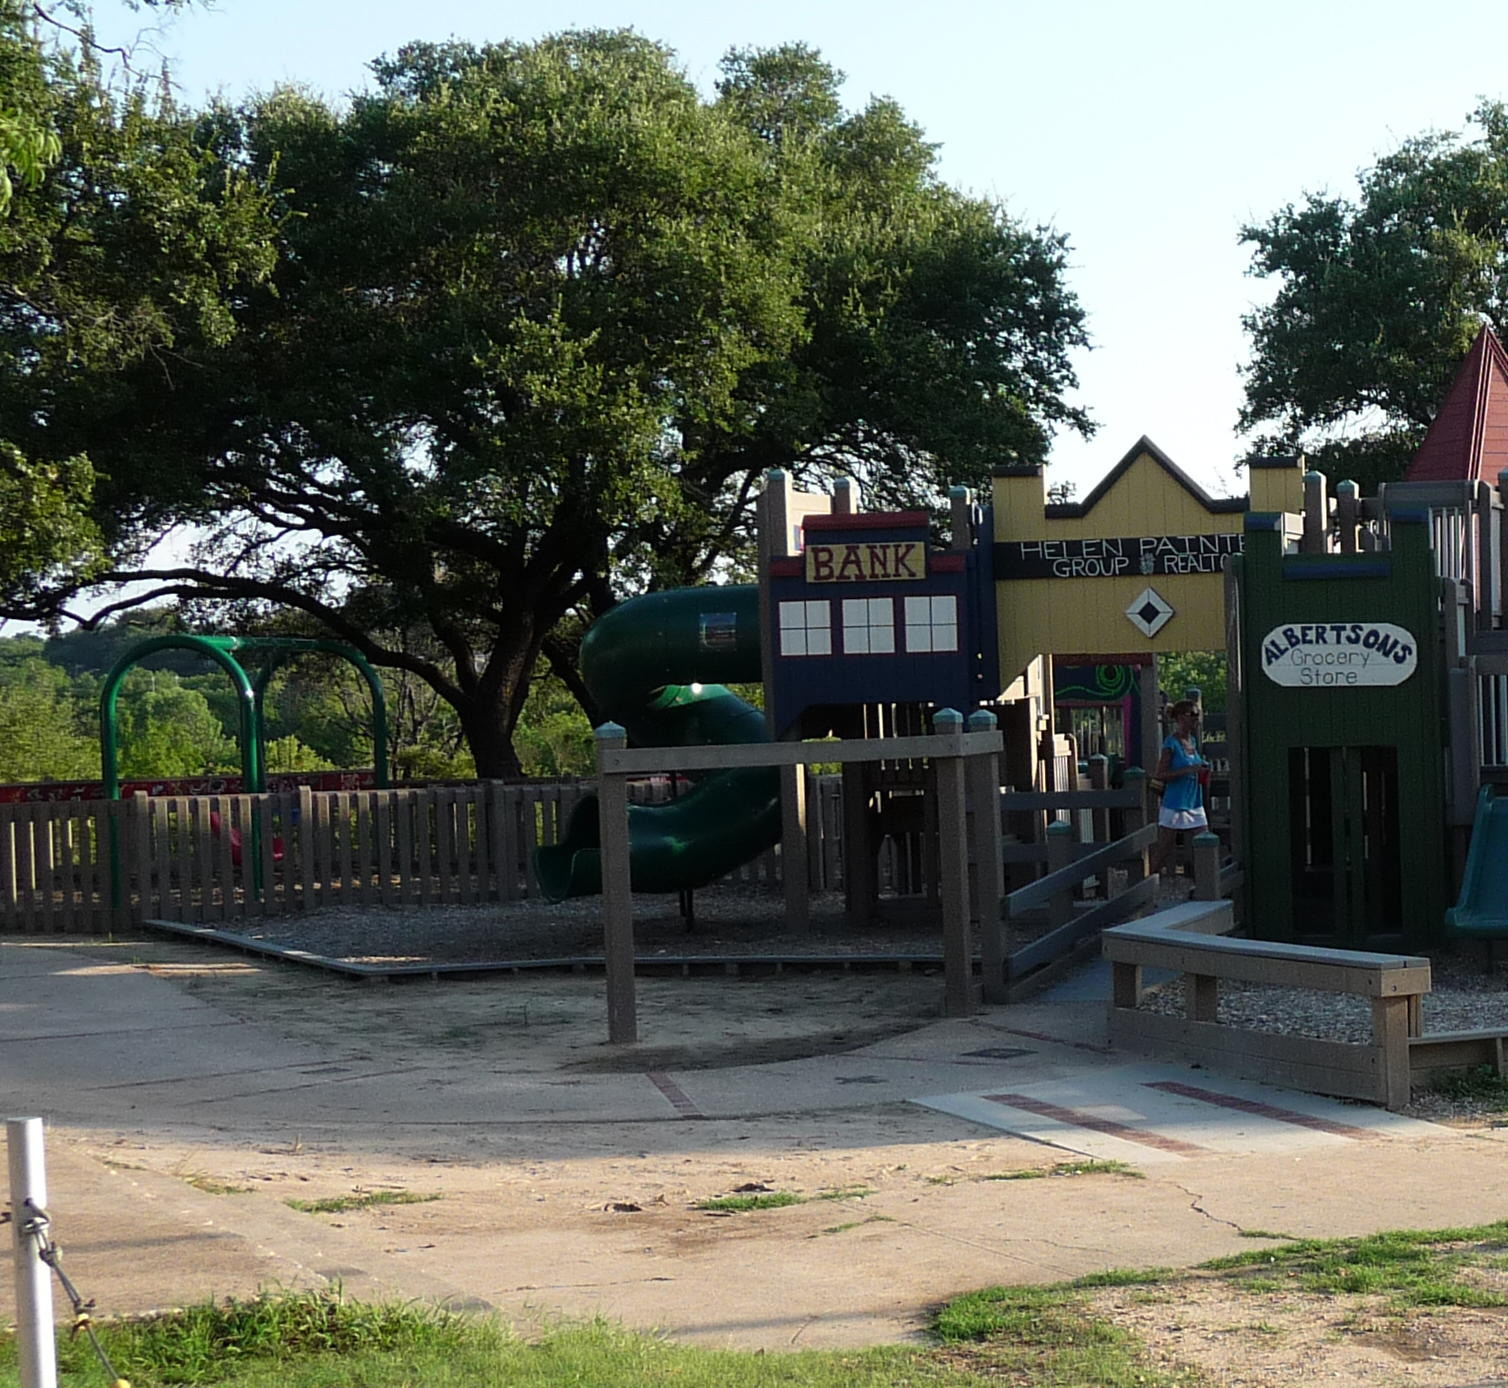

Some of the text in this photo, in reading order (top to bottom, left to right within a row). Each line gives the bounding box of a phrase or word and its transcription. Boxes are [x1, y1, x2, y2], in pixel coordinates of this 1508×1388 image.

[1020, 538, 1123, 560] HELEN
[811, 543, 918, 581] BANK
[1053, 556, 1129, 578] GROUP
[1264, 624, 1413, 666] ALBERTSONS
[1290, 648, 1370, 668] Grocery
[1300, 667, 1358, 685] Store
